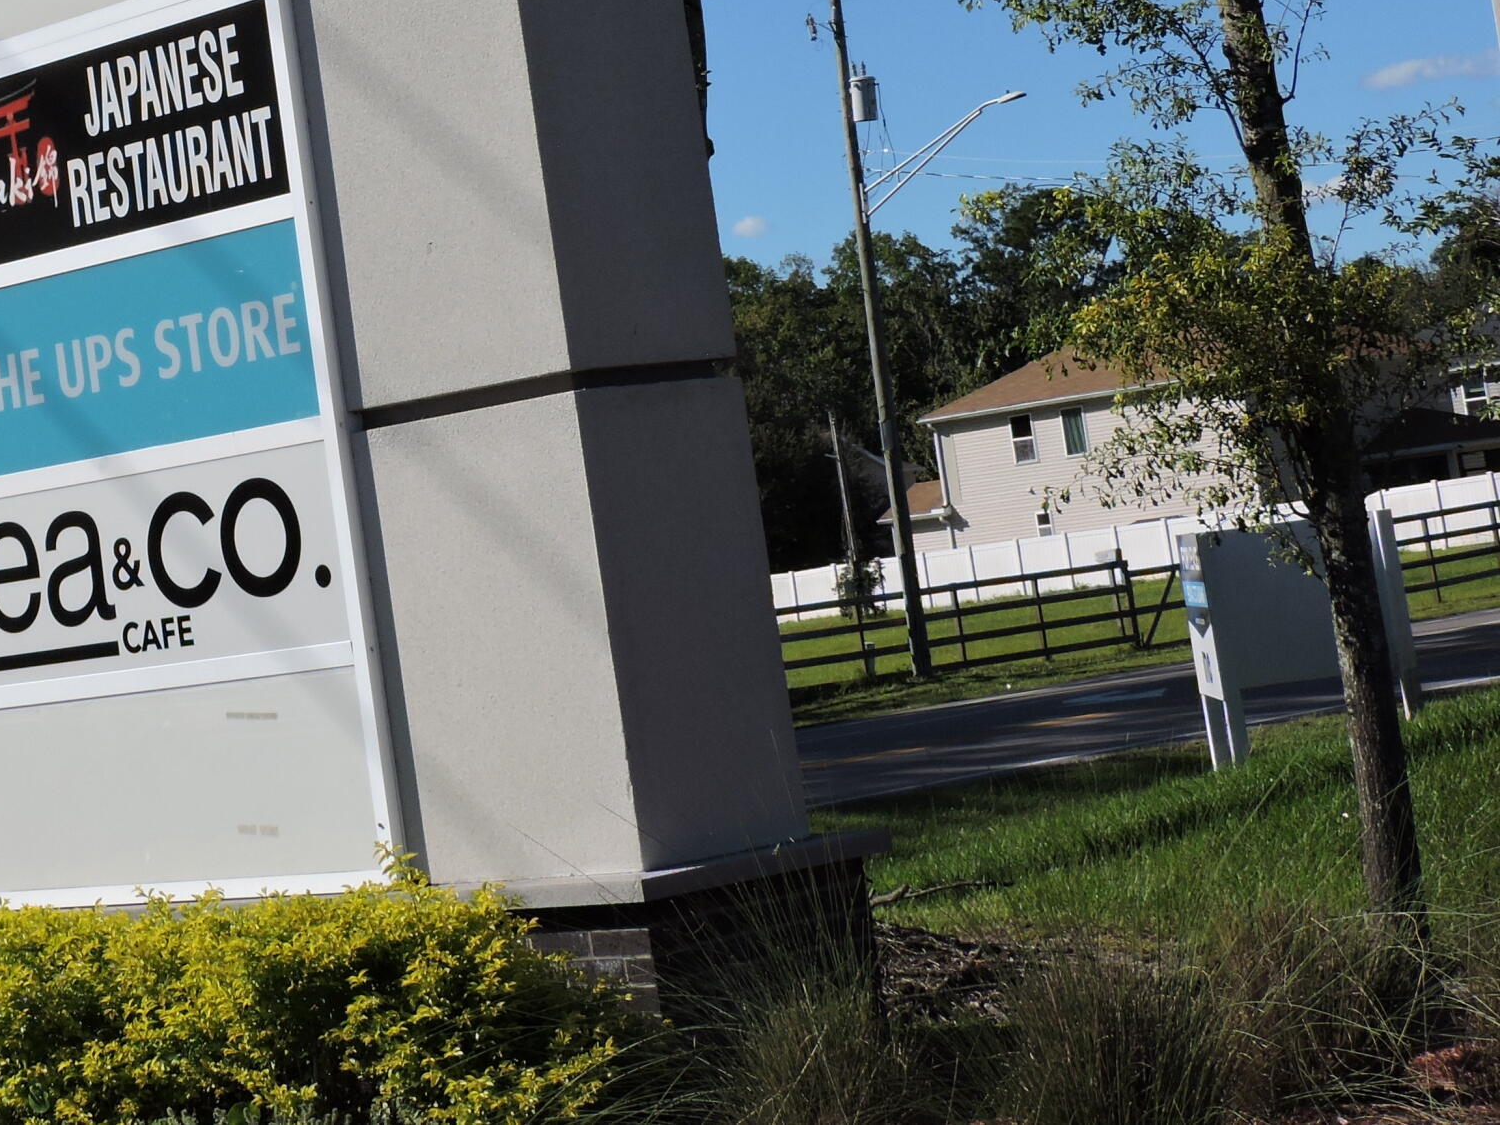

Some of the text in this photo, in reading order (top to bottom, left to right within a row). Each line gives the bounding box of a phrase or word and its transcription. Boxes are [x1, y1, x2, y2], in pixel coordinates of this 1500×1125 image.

[84, 23, 245, 137] JAPANESE
[66, 106, 274, 228] RESTAURANT
[55, 328, 141, 399] UPS
[154, 293, 301, 380] STORE
[122, 615, 195, 654] CAFE
